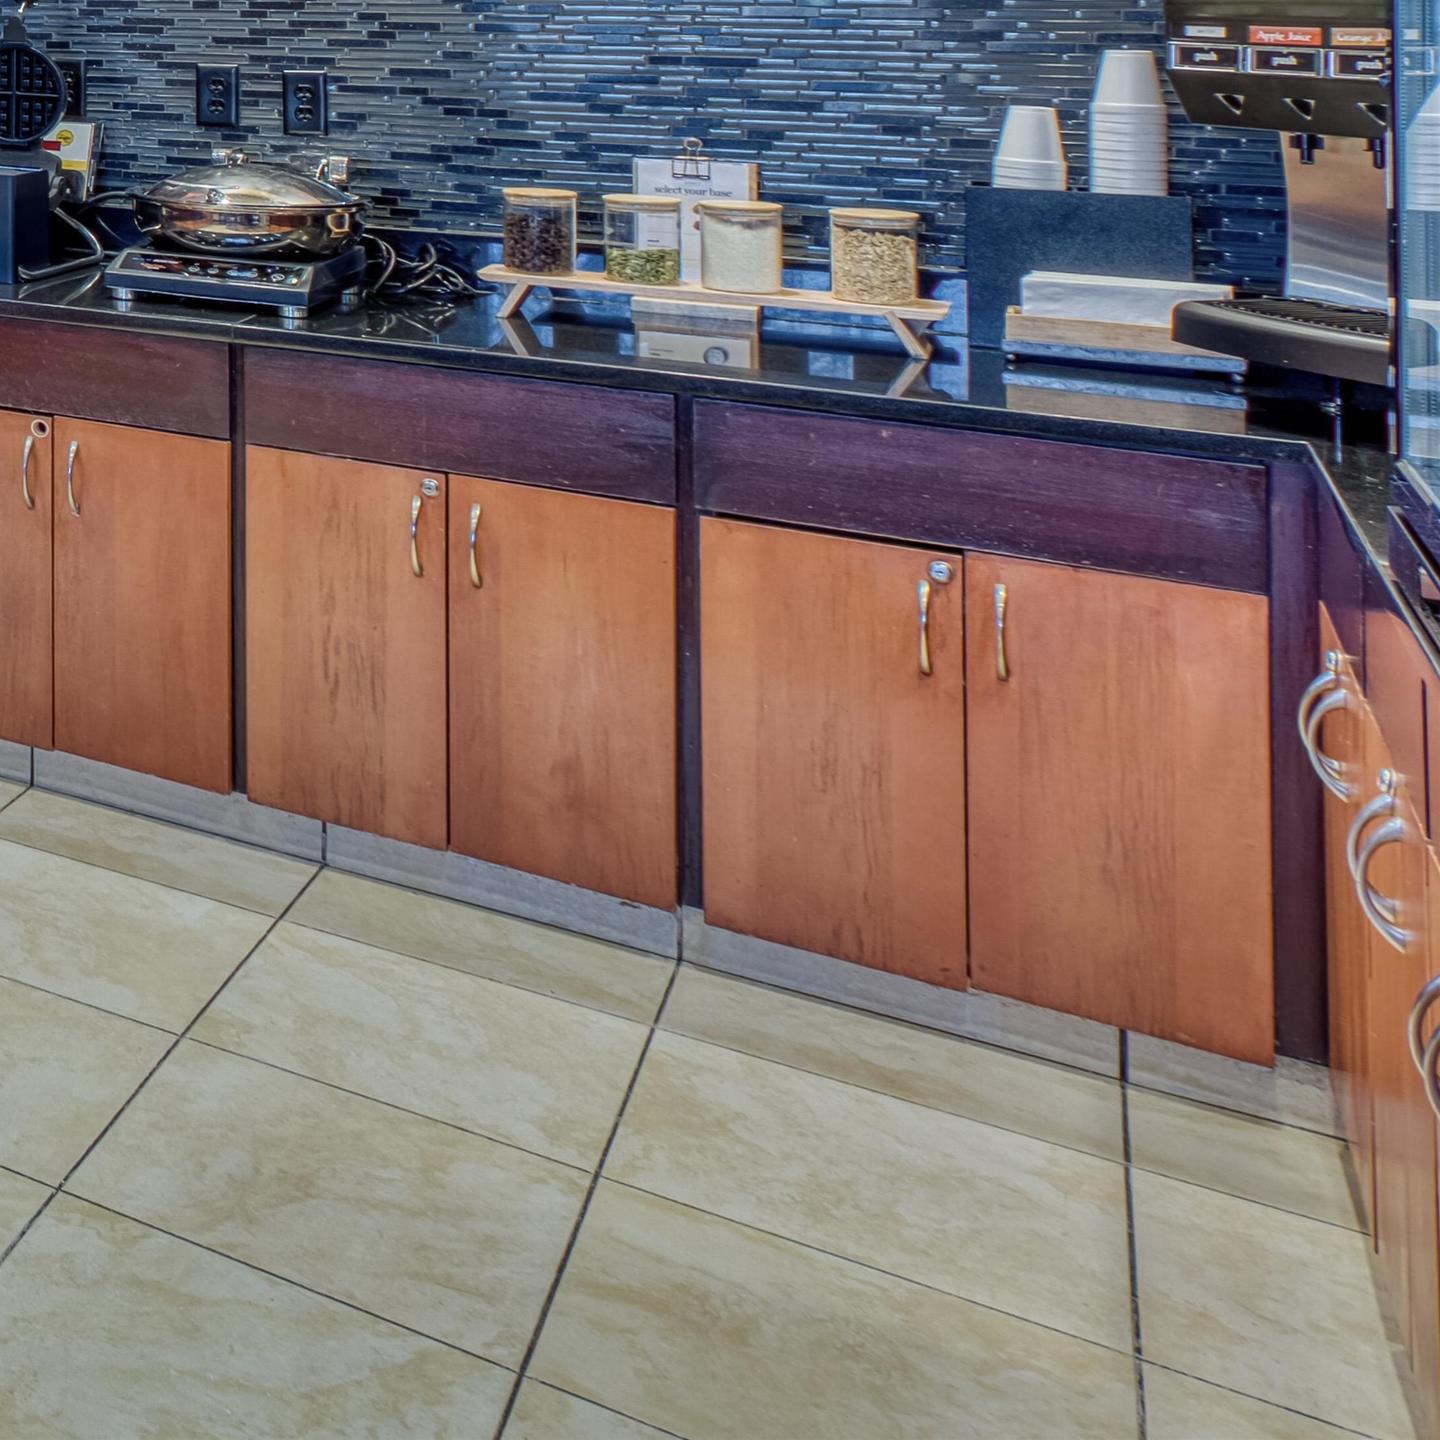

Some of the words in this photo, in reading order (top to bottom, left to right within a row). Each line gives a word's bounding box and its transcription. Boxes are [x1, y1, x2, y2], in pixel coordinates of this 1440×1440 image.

[1256, 30, 1286, 43] Apple
[1288, 31, 1313, 42] Juice
[1193, 51, 1219, 62] push
[1271, 55, 1298, 66] push
[654, 184, 682, 194] select
[684, 188, 708, 197] your
[709, 187, 733, 198] base
